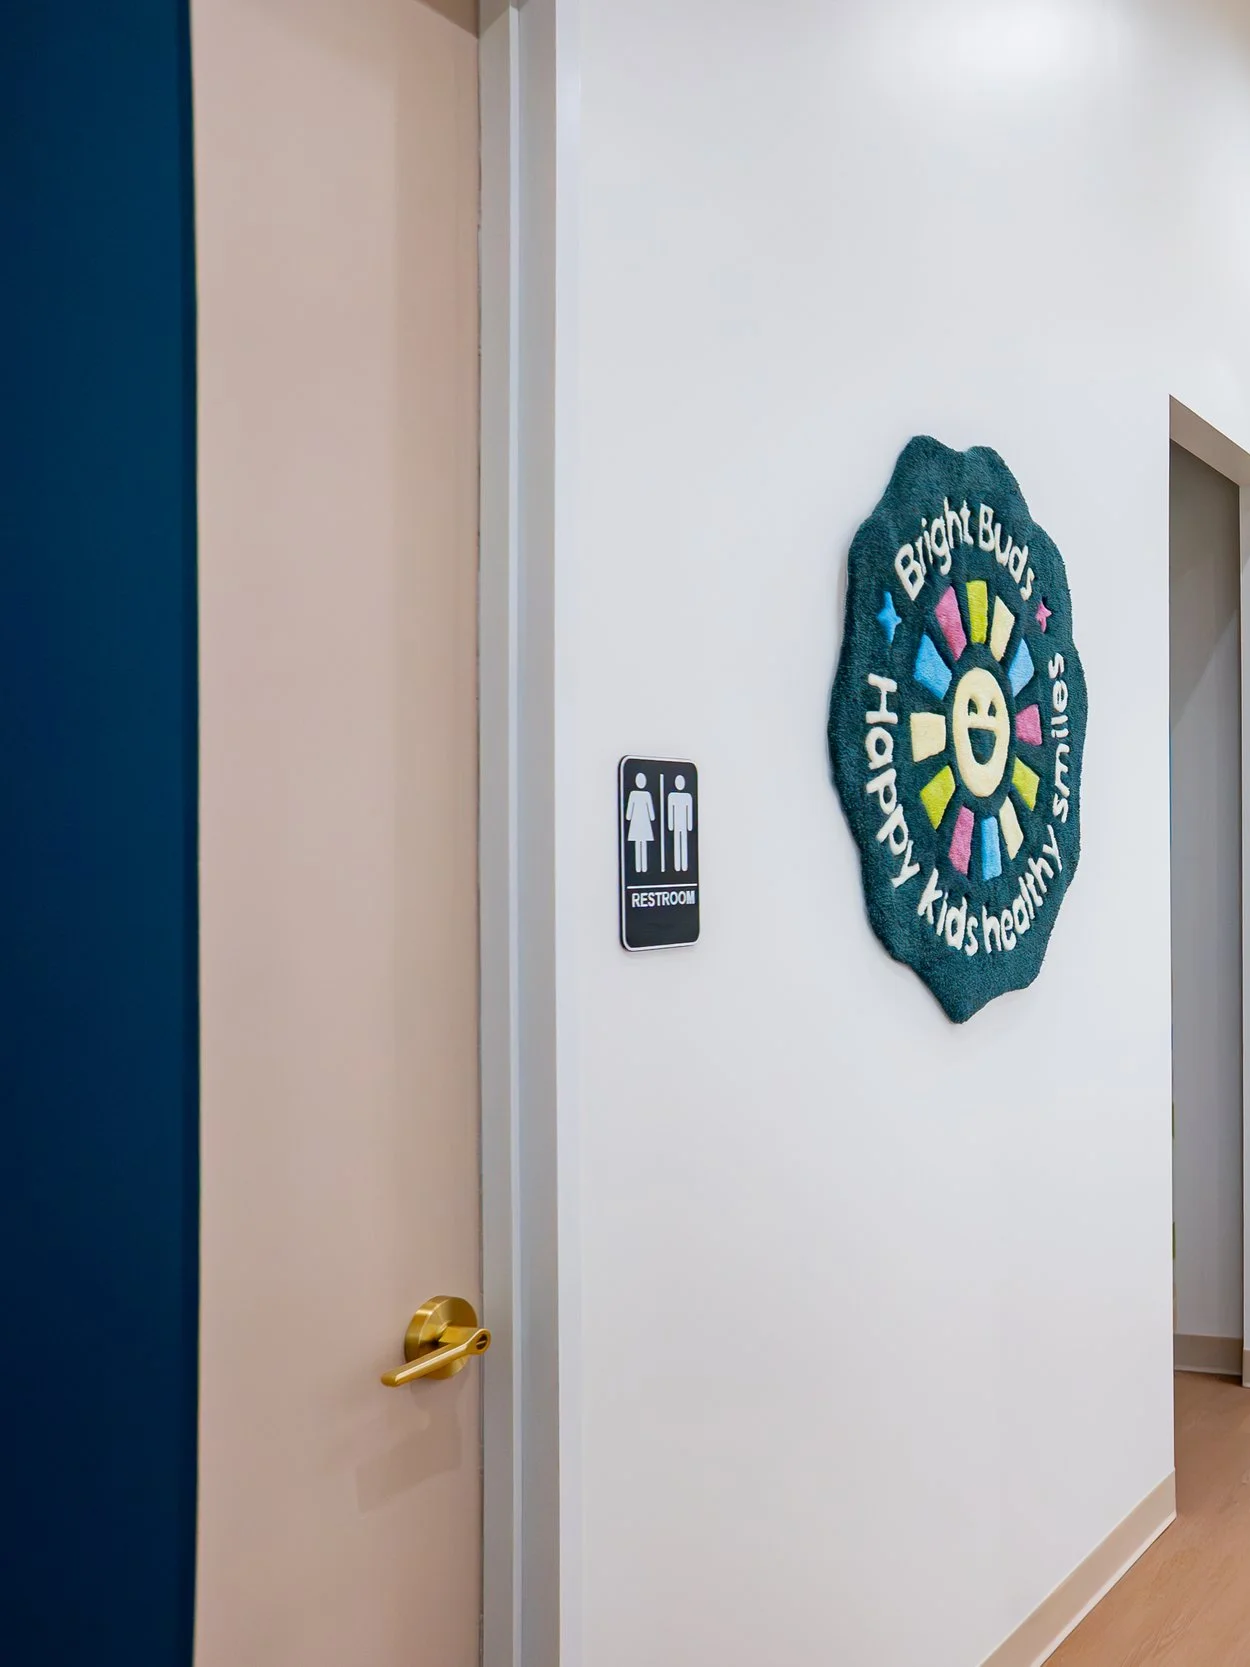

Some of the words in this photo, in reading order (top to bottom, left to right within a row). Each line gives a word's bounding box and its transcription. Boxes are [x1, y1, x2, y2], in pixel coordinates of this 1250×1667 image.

[894, 496, 974, 601] Bright
[978, 502, 1035, 601] Buds
[865, 673, 921, 889] Happy
[917, 868, 979, 957] kids
[982, 824, 1063, 954] healthy
[1048, 653, 1071, 824] smiles
[631, 890, 696, 908] RESTROOM
